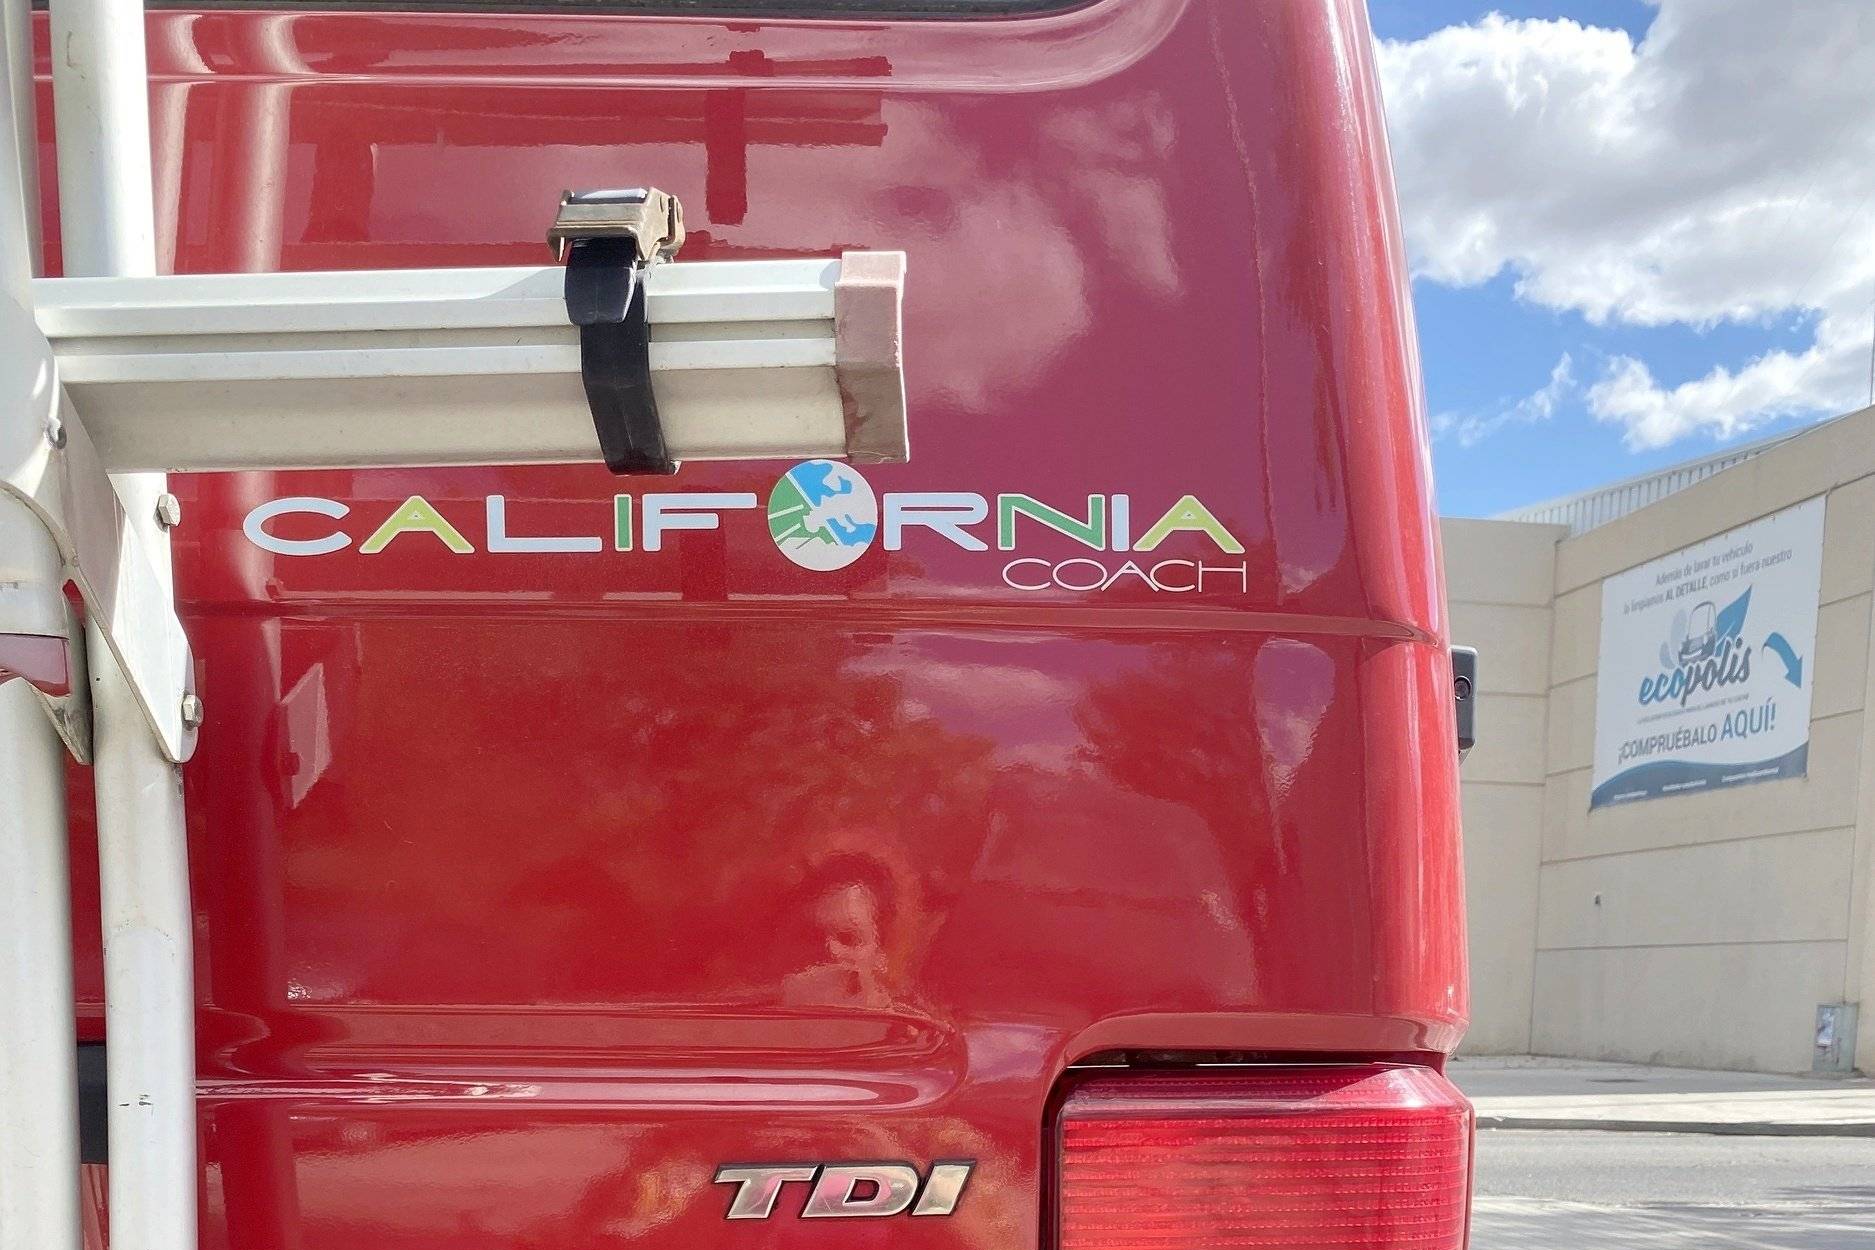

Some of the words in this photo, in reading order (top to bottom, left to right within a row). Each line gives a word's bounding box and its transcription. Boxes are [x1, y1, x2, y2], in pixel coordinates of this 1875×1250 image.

[1002, 557, 1246, 593] COACH
[1683, 563, 1692, 577] de
[1720, 696, 1777, 740] AQUÍ!
[714, 1160, 976, 1219] TDI
